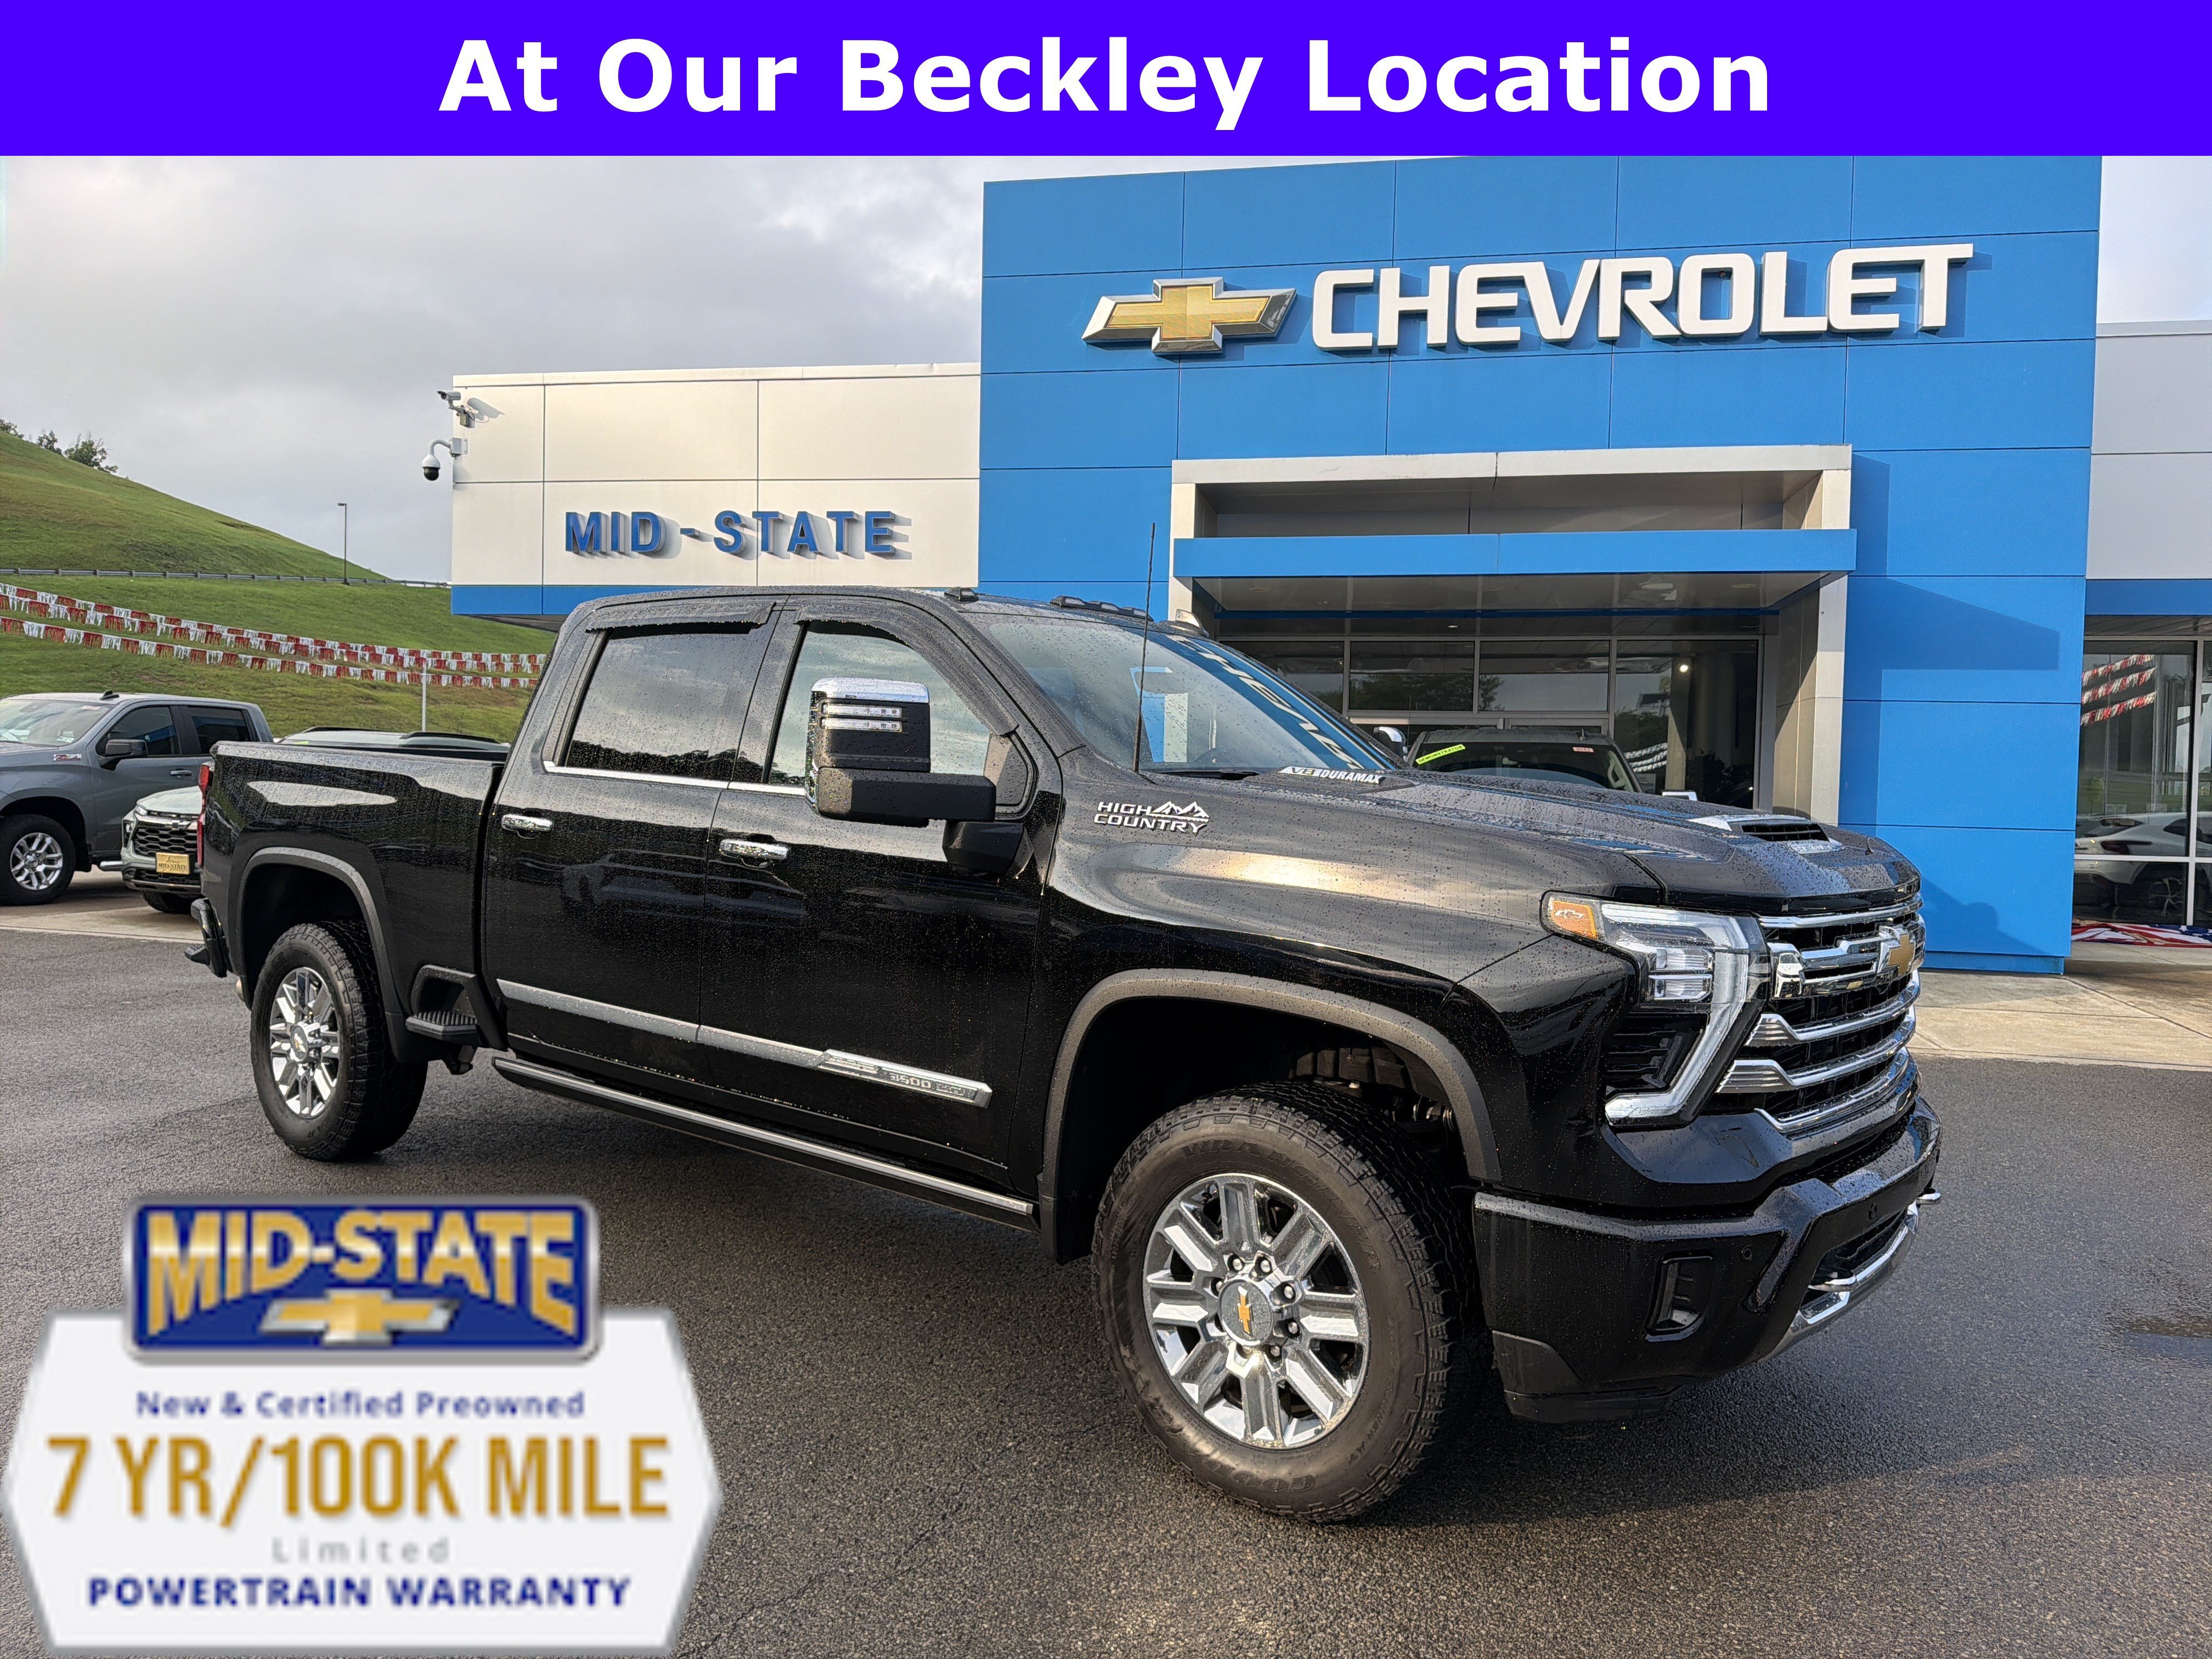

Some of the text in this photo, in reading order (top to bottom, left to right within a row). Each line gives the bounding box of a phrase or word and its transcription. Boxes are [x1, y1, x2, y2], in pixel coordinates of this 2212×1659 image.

[1312, 242, 1973, 351] CHEVROLET
[1418, 746, 1464, 763] DEMONSTRATOR
[1318, 769, 1384, 784] DURAMAX
[1097, 802, 1152, 816] HIGH
[1093, 813, 1208, 834] COUNTRY
[889, 1072, 932, 1089] 3500
